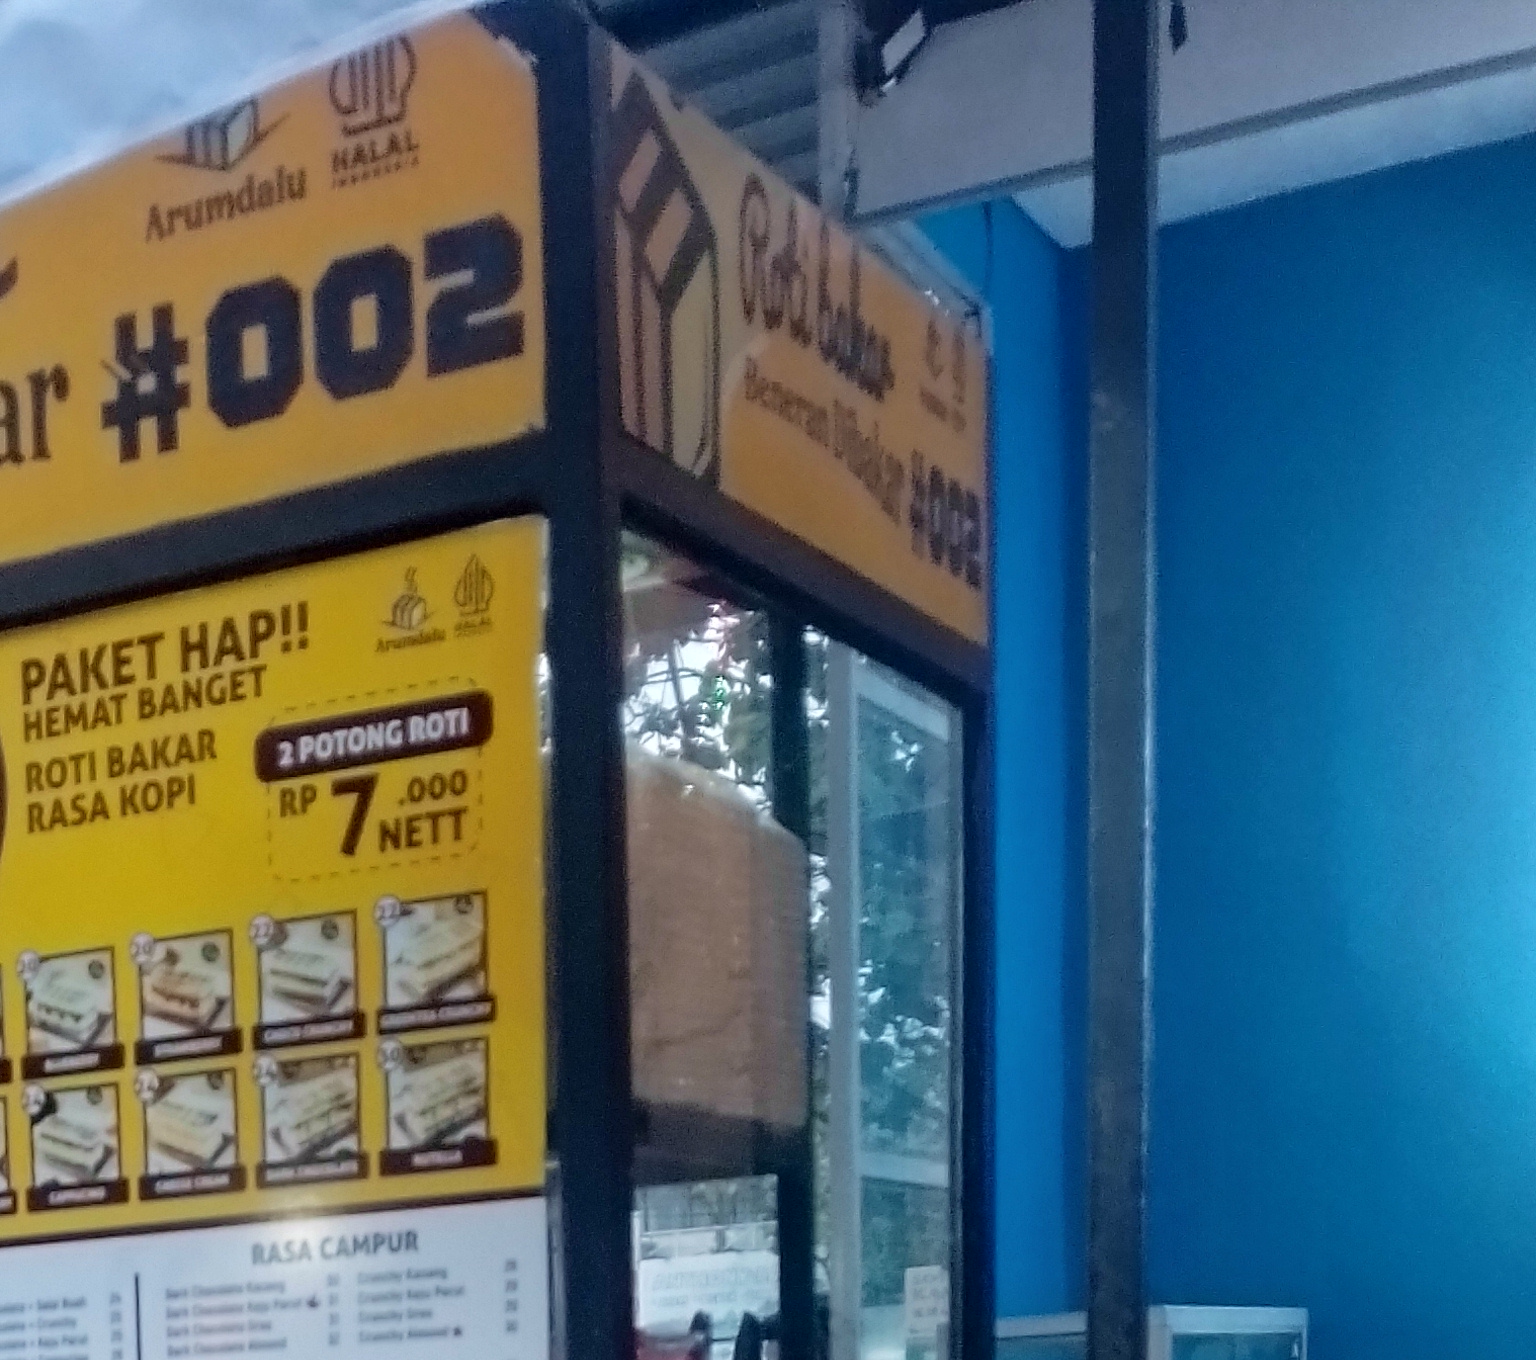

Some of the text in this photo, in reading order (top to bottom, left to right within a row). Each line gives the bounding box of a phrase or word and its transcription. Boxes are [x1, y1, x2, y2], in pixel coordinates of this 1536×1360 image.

[332, 130, 419, 174] HALAL
[145, 164, 306, 243] Arumdalu
[101, 211, 525, 463] #002
[21, 600, 309, 705] PAKET HAP!!
[23, 663, 268, 743] HEMAT BANGET
[25, 728, 218, 794] ROTI BAKAR
[277, 706, 470, 768] 2 POTONG ROTI
[27, 772, 196, 835] RASA KOPI
[279, 783, 317, 818] RP
[330, 771, 381, 858] 7
[378, 805, 469, 854] NETT
[251, 1230, 419, 1266] RASA CAMPUR
